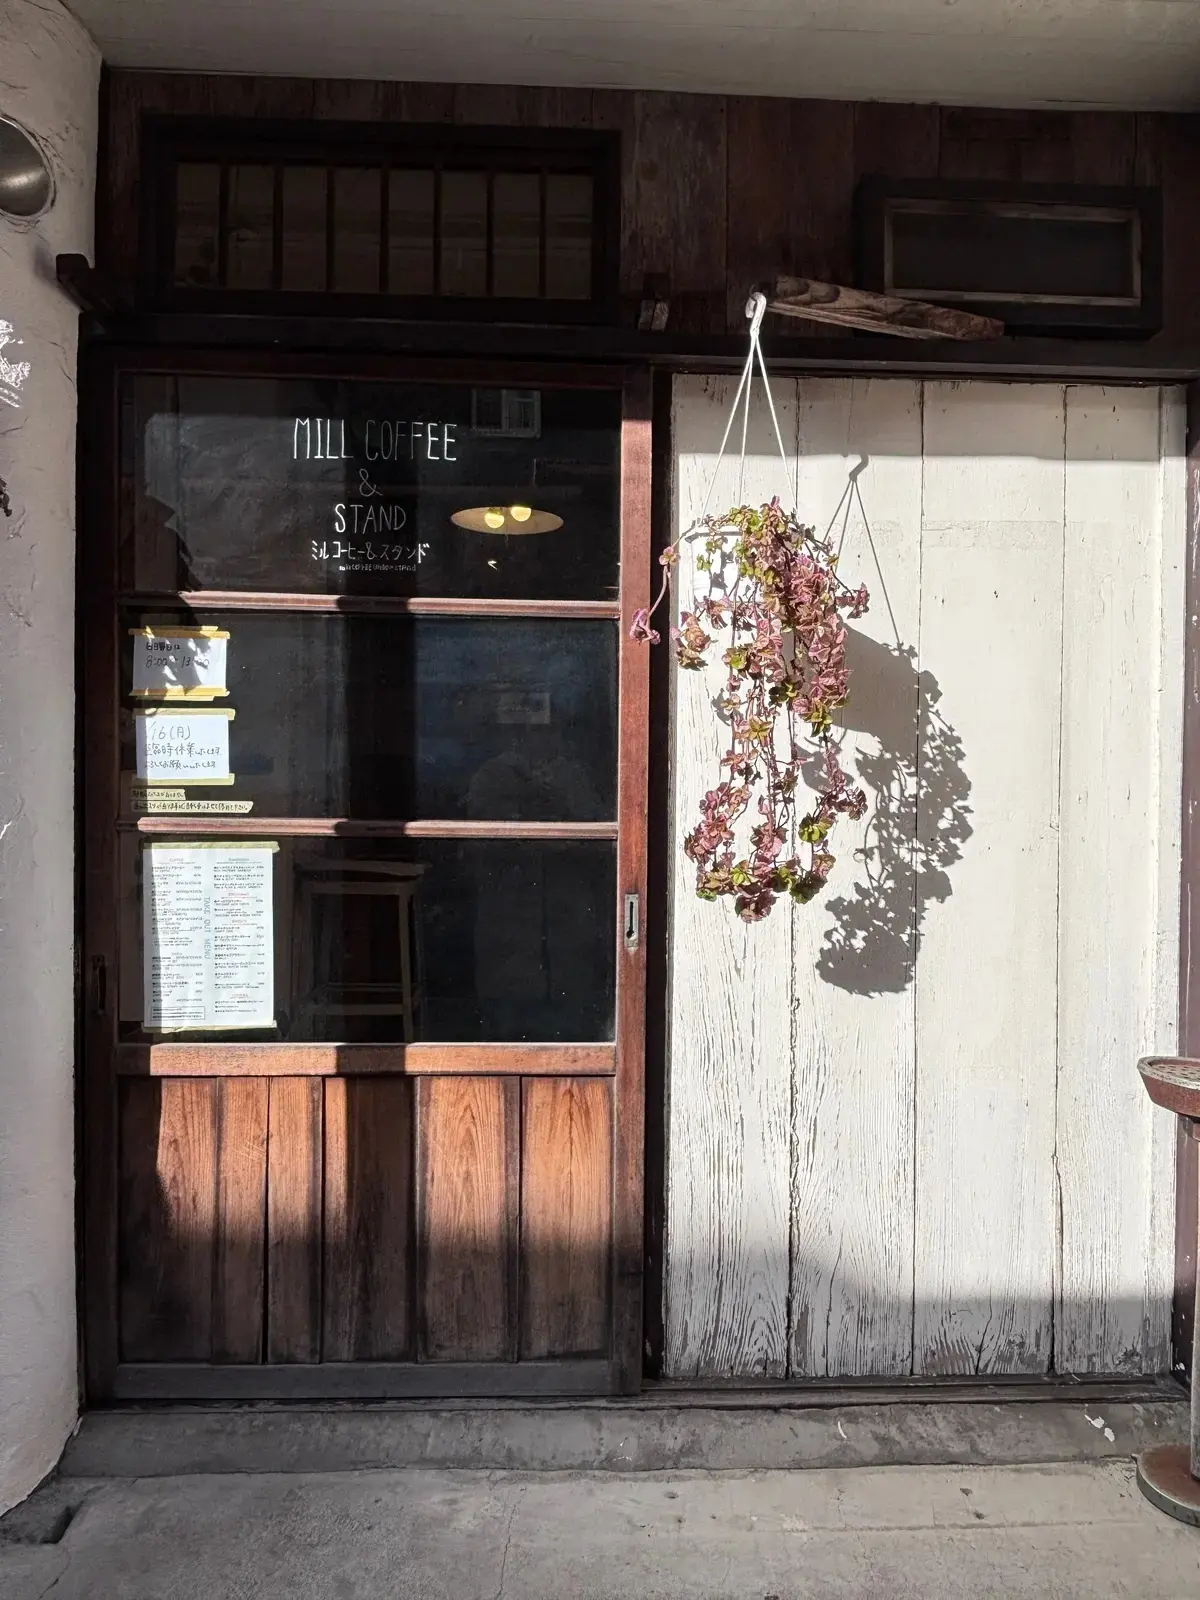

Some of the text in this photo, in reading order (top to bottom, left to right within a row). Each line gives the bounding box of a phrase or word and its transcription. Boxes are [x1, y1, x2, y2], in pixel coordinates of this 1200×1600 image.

[293, 417, 458, 462] MILL COFFEE
[358, 468, 384, 498] &
[334, 503, 407, 535] STAND
[203, 919, 211, 933] OUT
[204, 938, 212, 960] MENU
